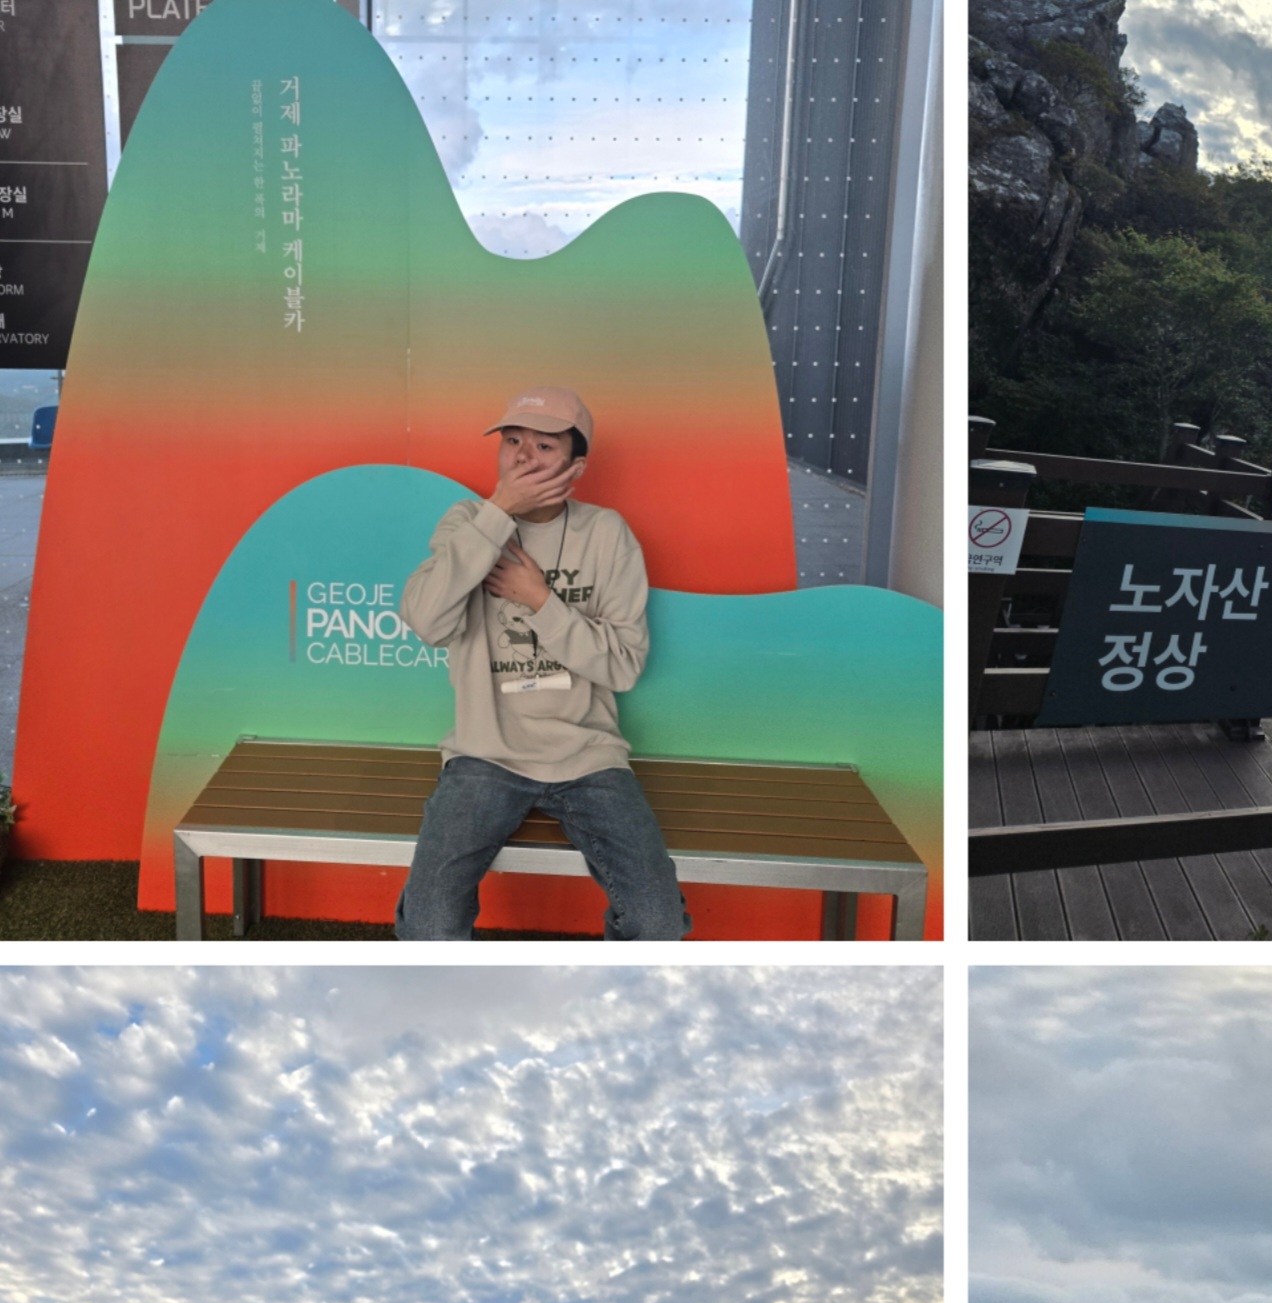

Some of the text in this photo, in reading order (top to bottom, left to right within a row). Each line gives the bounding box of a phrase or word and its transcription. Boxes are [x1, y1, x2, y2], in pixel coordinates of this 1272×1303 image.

[280, 76, 305, 333] 거제 파노라마 케이블카
[968, 554, 1004, 566] 연구역
[307, 582, 394, 606] GEOJE
[1109, 564, 1270, 620] 노자산
[307, 642, 449, 668] CABLECAR
[1098, 631, 1208, 691] 정상
